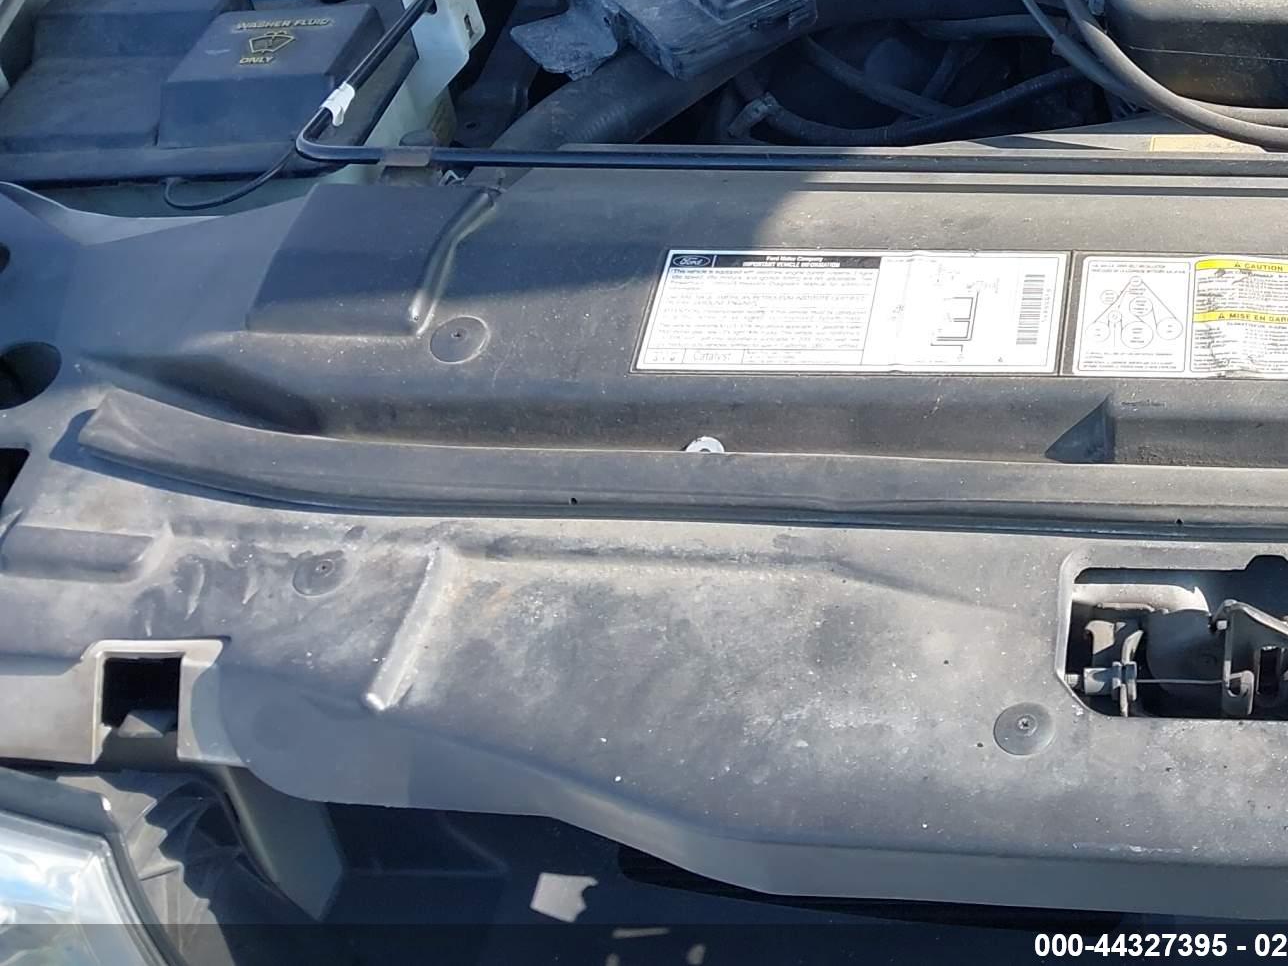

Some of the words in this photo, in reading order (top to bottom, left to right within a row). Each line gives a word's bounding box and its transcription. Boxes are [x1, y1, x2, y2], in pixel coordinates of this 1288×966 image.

[236, 20, 292, 31] WASHER
[294, 17, 331, 28] FLUID
[239, 56, 275, 66] ONLY
[1244, 262, 1284, 271] CAUTION
